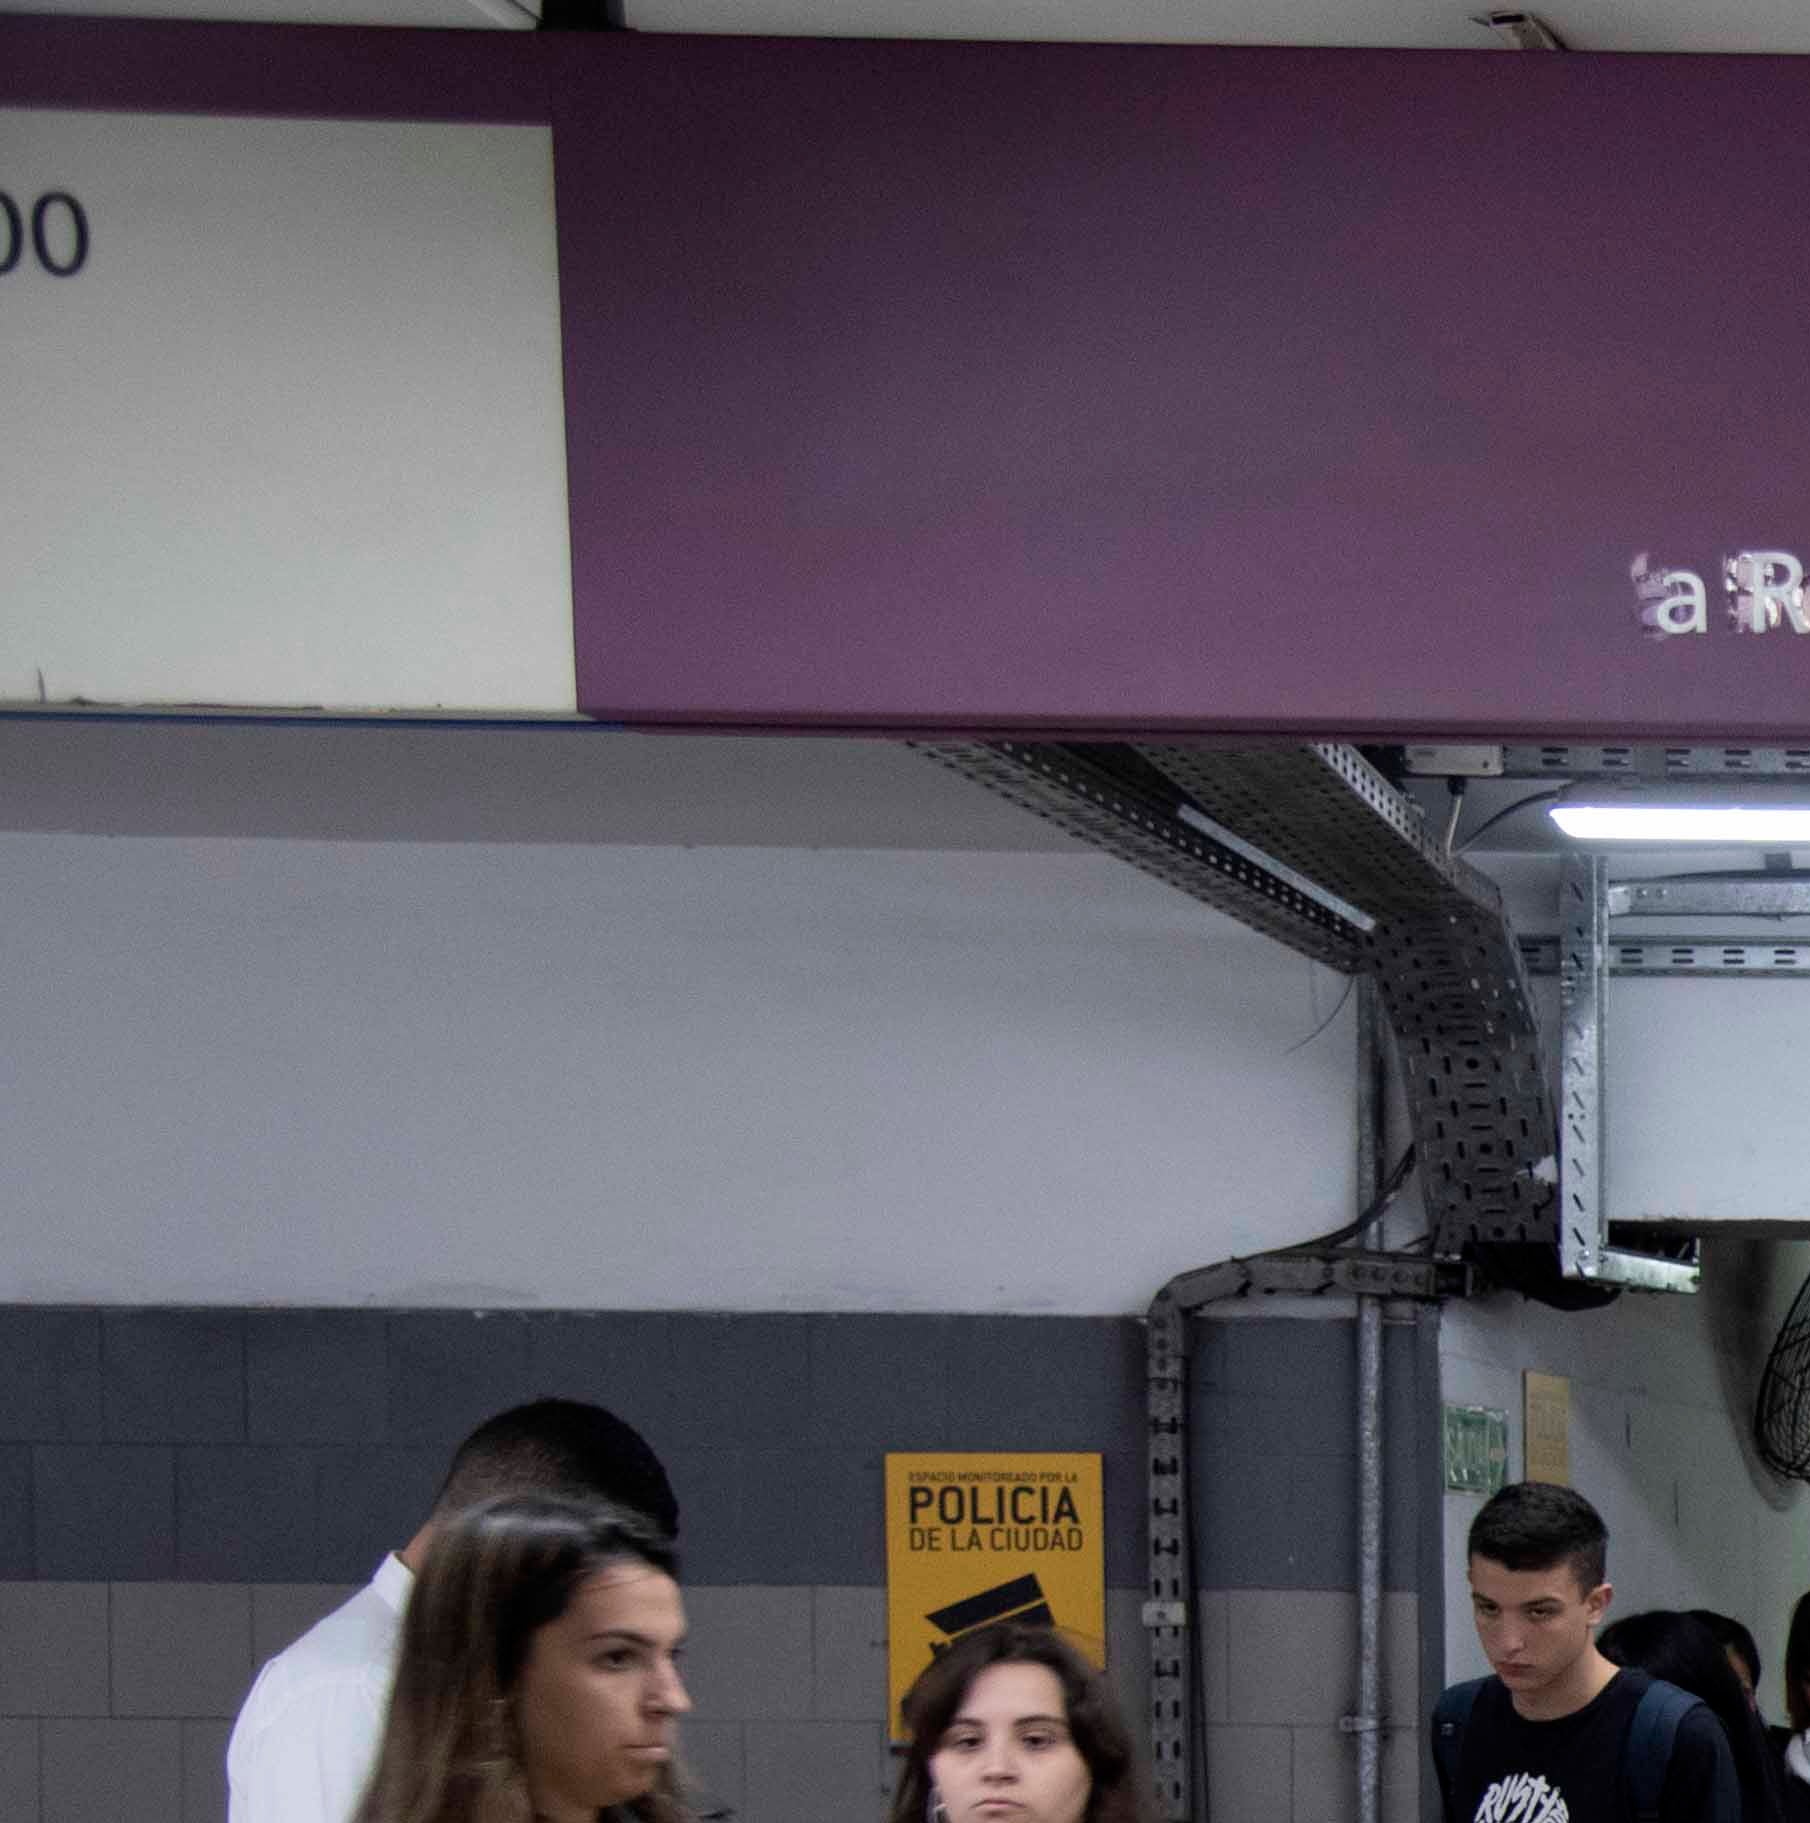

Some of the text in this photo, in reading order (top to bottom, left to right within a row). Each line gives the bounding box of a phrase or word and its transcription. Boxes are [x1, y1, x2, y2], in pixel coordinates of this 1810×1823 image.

[1655, 570, 1708, 635] a
[909, 1485, 1080, 1526] POLICIA
[909, 1527, 1084, 1552] DE LA CIUDAD
